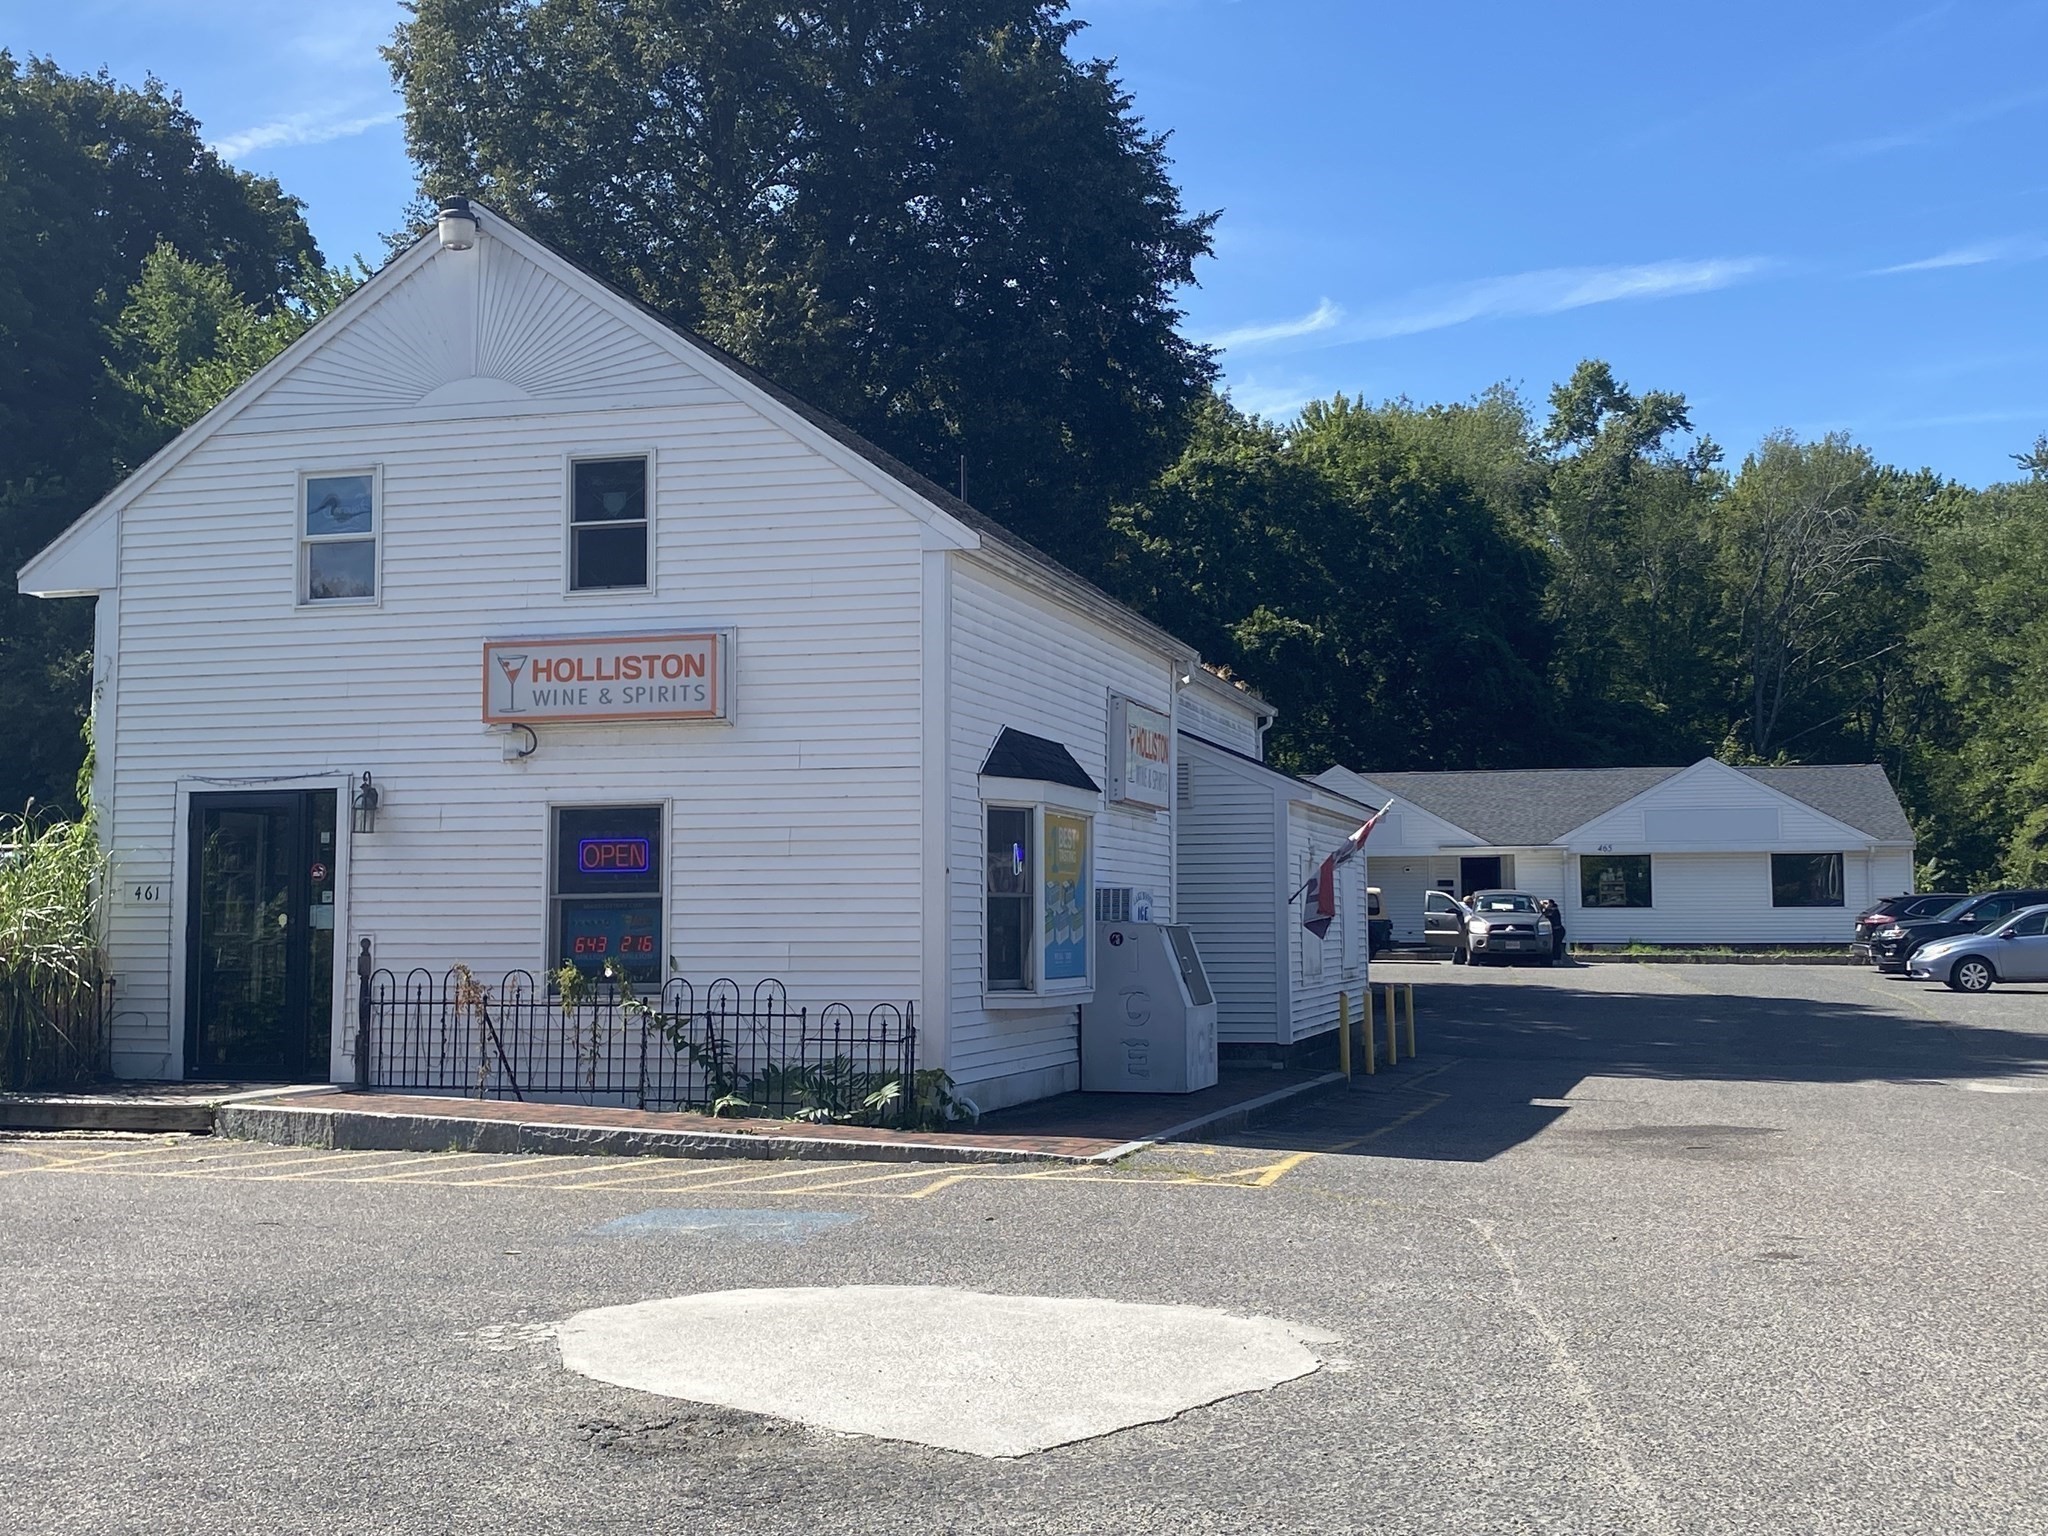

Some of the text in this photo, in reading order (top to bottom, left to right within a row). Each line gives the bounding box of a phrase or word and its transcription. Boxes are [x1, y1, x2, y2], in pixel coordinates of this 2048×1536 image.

[531, 653, 705, 683] HOLLISTON
[532, 684, 706, 706] WINE & SPIRITS
[1136, 725, 1169, 764] HOLLISTON
[1058, 827, 1076, 849] BEST
[582, 844, 646, 867] OPEN
[1597, 844, 1613, 852] 465
[134, 885, 159, 901] 461
[1137, 906, 1149, 921] ICE
[574, 937, 608, 953] 643
[620, 935, 653, 952] 216
